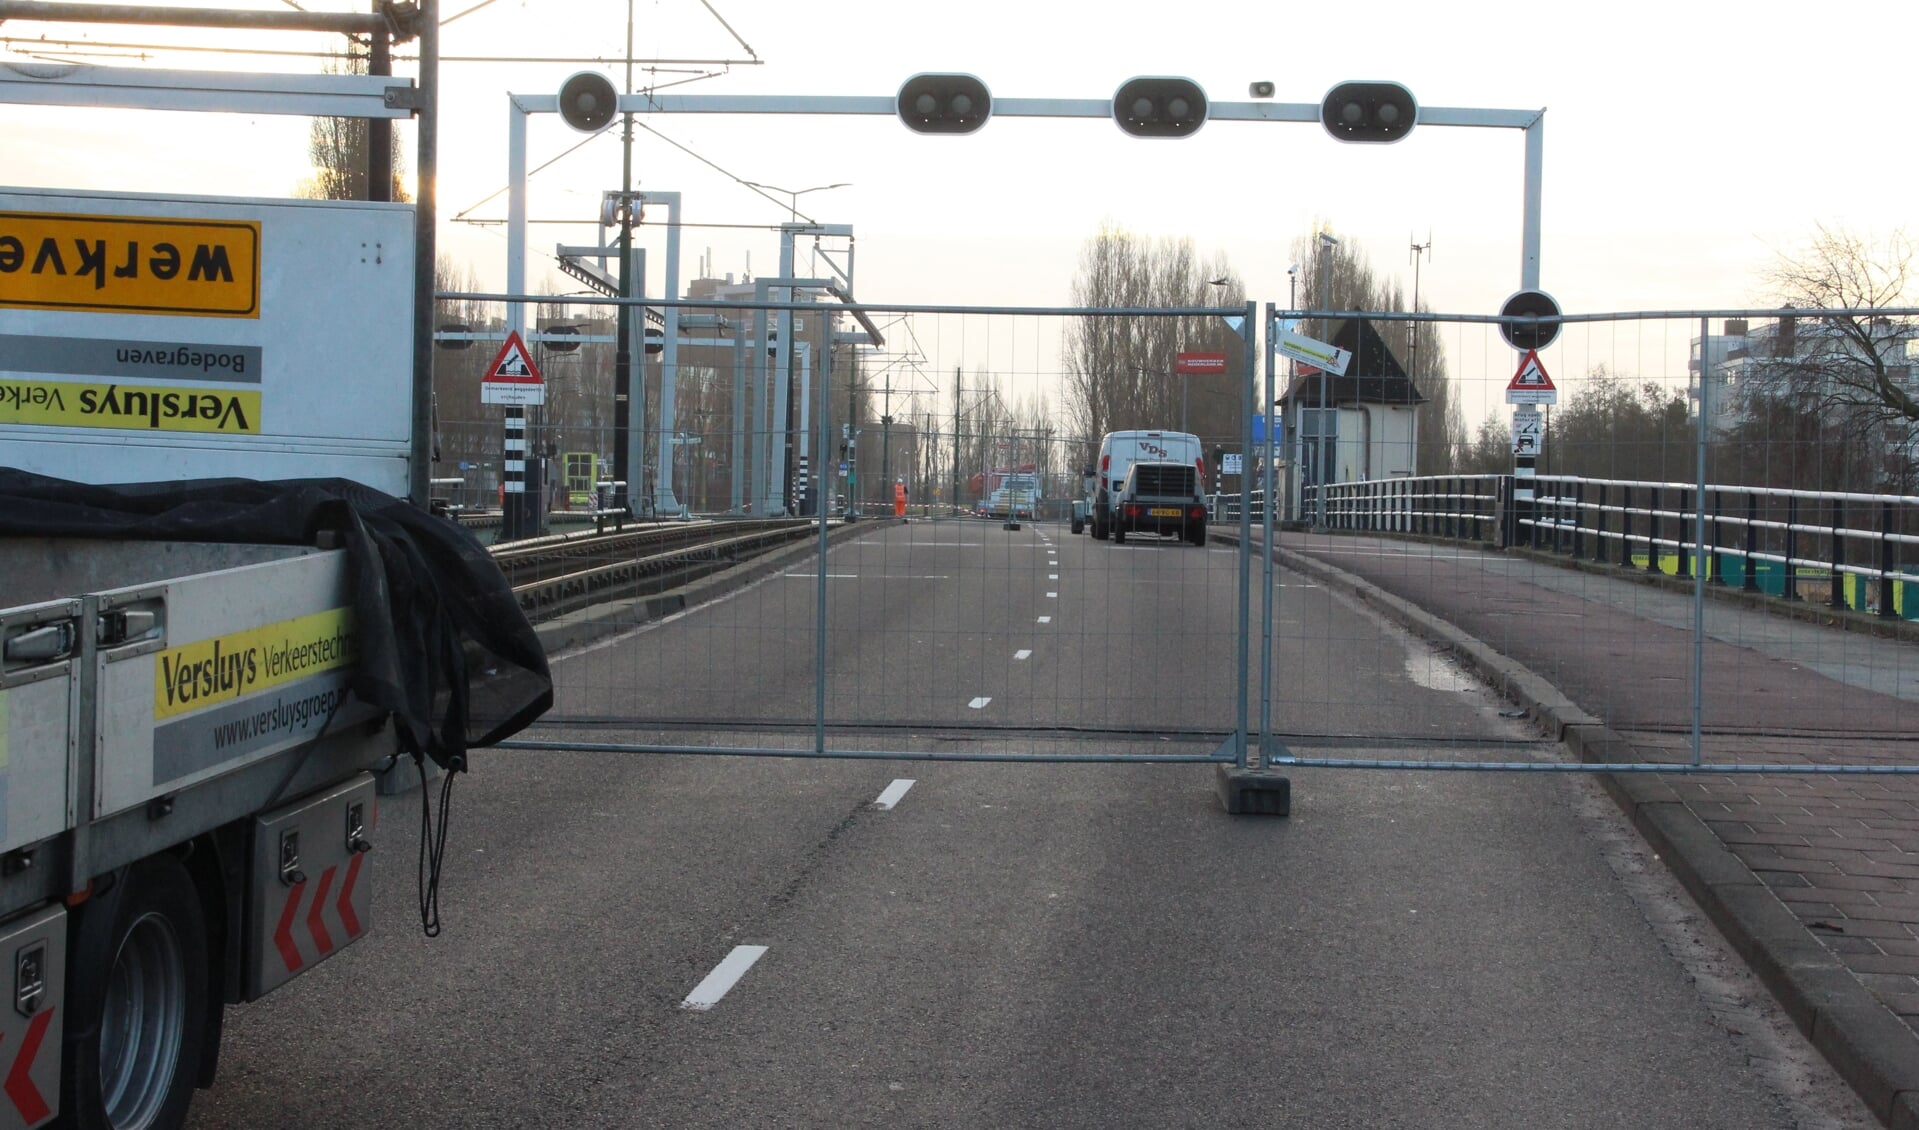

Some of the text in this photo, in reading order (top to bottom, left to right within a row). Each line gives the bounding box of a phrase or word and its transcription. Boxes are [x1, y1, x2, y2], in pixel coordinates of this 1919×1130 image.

[0, 235, 234, 289] werkve
[116, 346, 245, 373] Bodegraven
[80, 384, 249, 430] Versluys
[1139, 442, 1168, 458] VDS
[162, 640, 257, 706] Versluys
